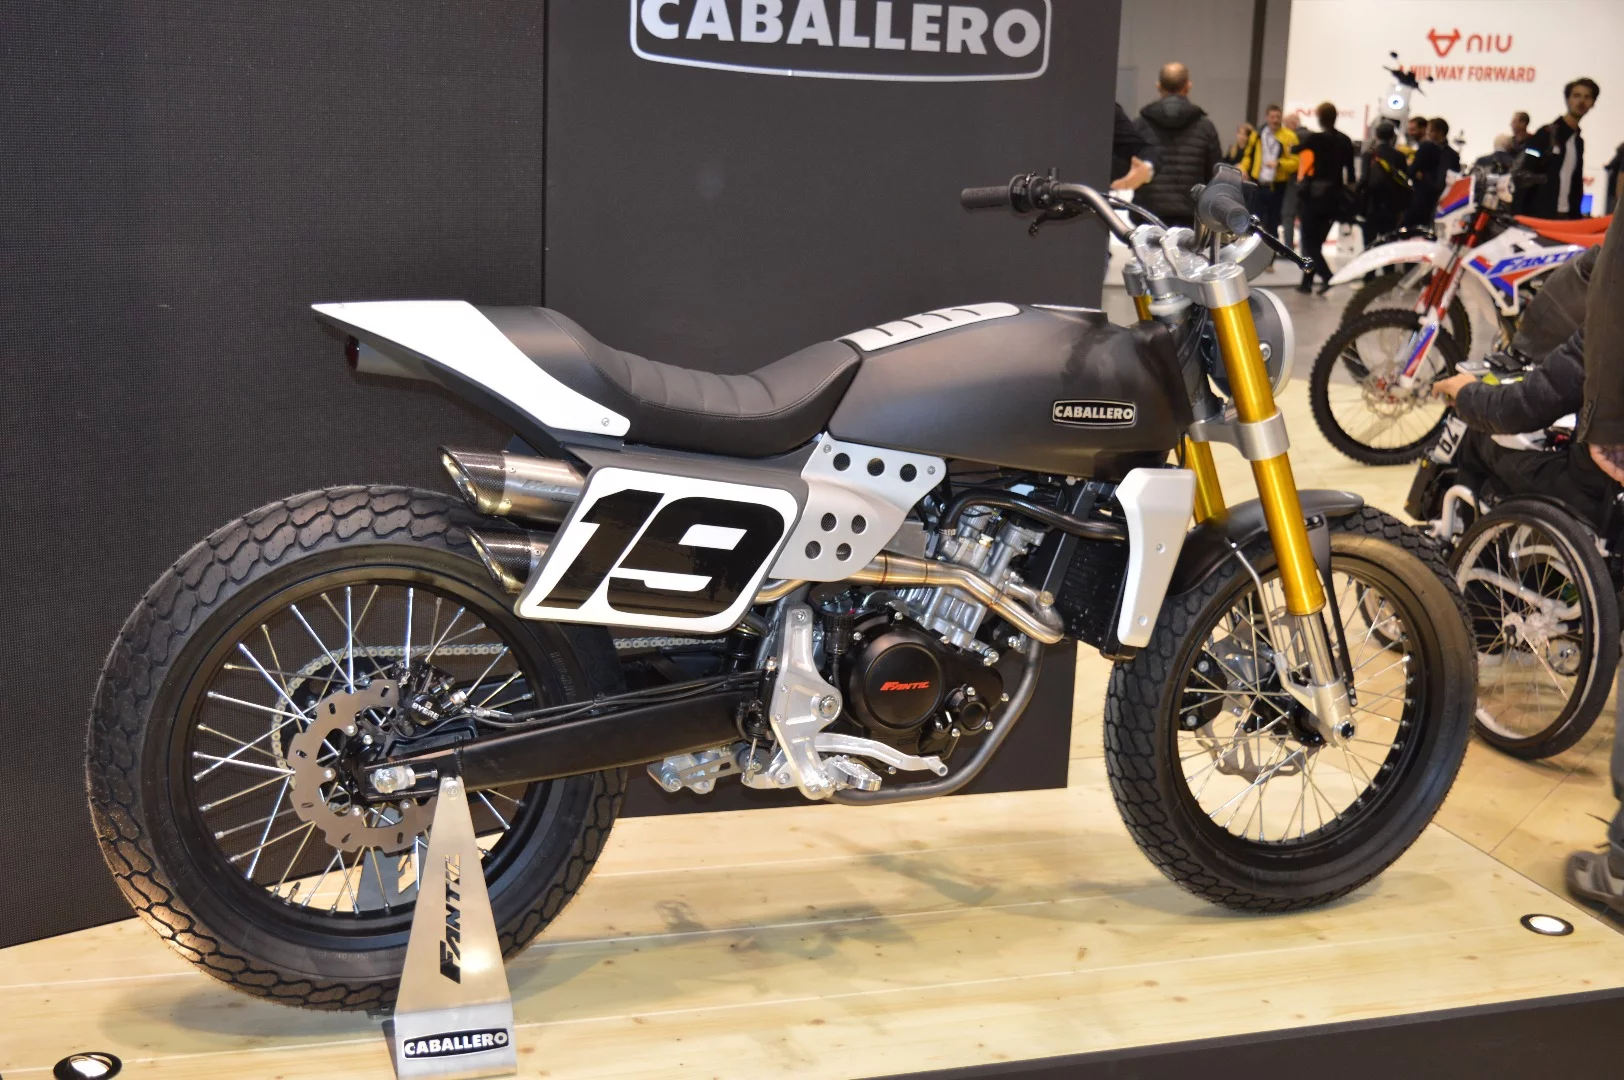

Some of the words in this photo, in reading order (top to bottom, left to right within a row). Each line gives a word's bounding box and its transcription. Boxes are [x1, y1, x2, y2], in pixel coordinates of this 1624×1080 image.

[640, 0, 1041, 58] CABALLERO
[1435, 65, 1465, 81] WAY
[1468, 66, 1536, 82] FORWARD
[1054, 405, 1134, 420] CABALLERO
[537, 488, 785, 619] 19
[880, 681, 930, 691] FANTIC
[440, 854, 461, 984] FANTIC
[404, 1031, 508, 1055] CABALLERO
